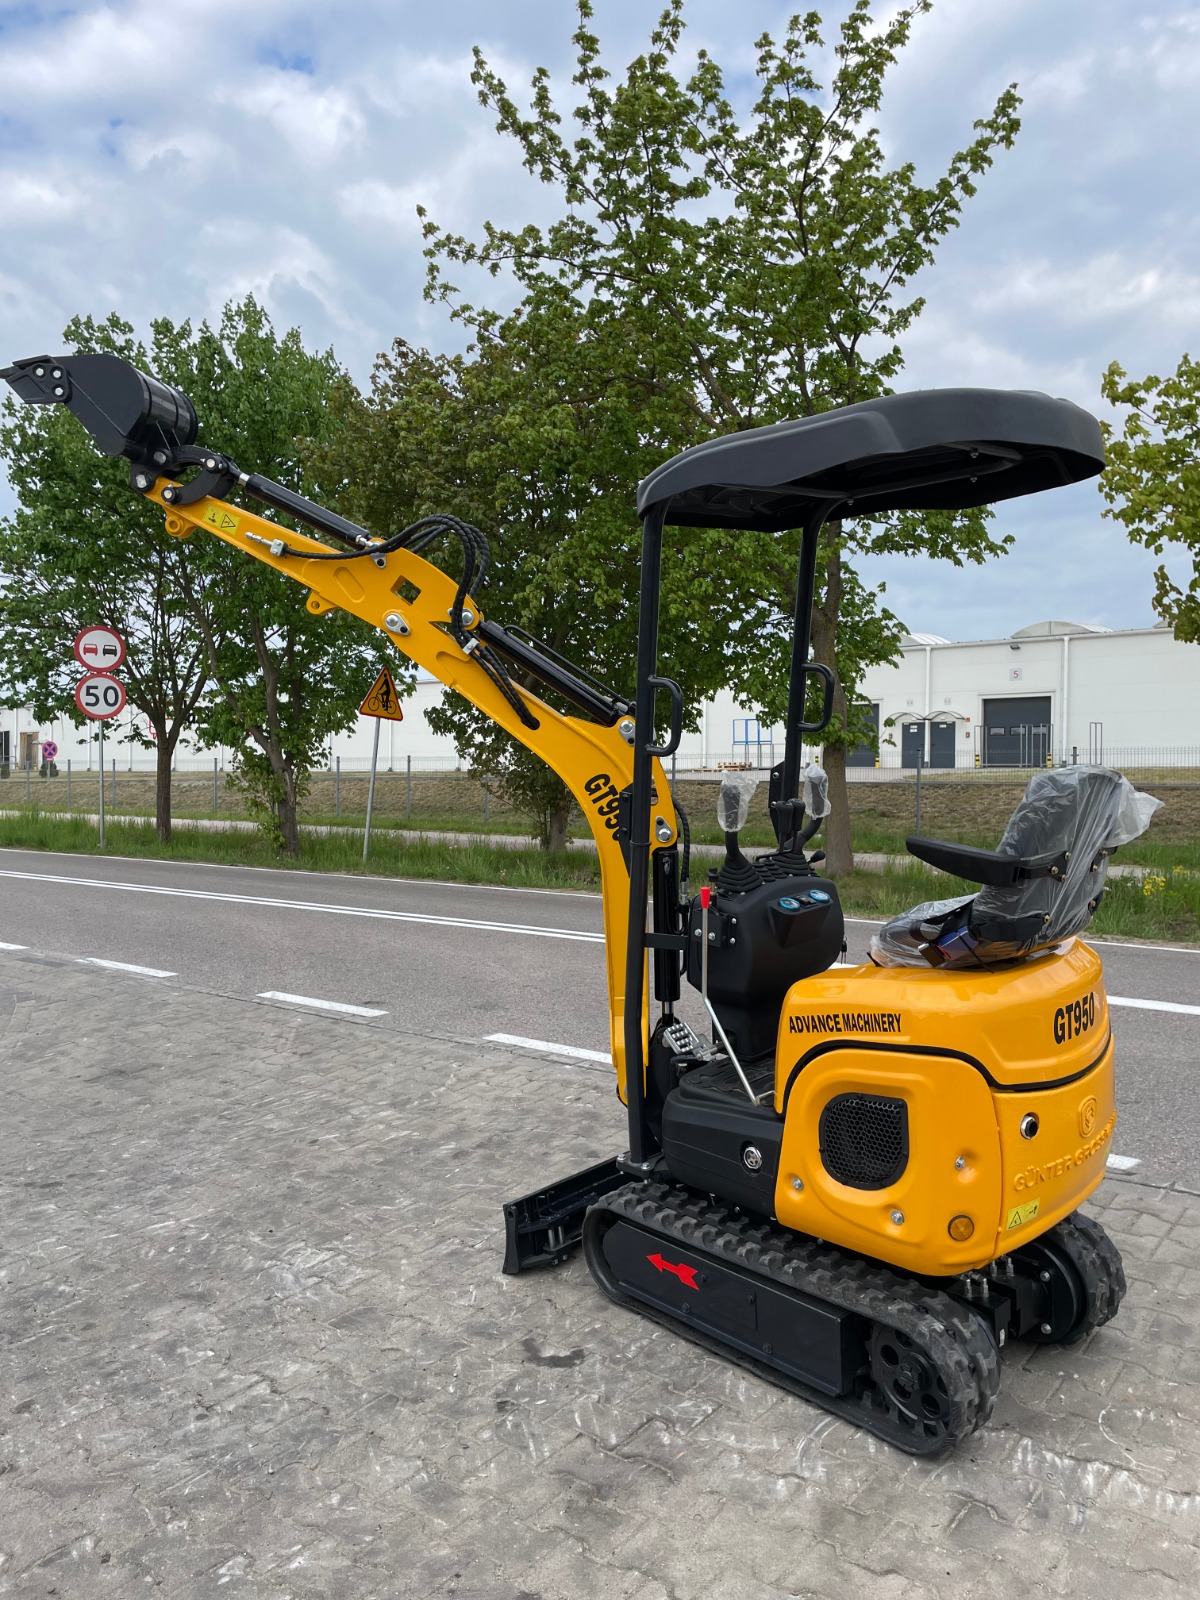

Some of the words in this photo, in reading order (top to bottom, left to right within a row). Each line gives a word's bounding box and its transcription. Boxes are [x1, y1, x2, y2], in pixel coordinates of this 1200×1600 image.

[1013, 670, 1018, 679] 5
[85, 685, 119, 707] 50
[789, 1013, 842, 1034] ADVANCE
[842, 1012, 901, 1033] MACHINERY
[1053, 991, 1095, 1045] GT950
[1013, 1154, 1072, 1191] GÜNTER
